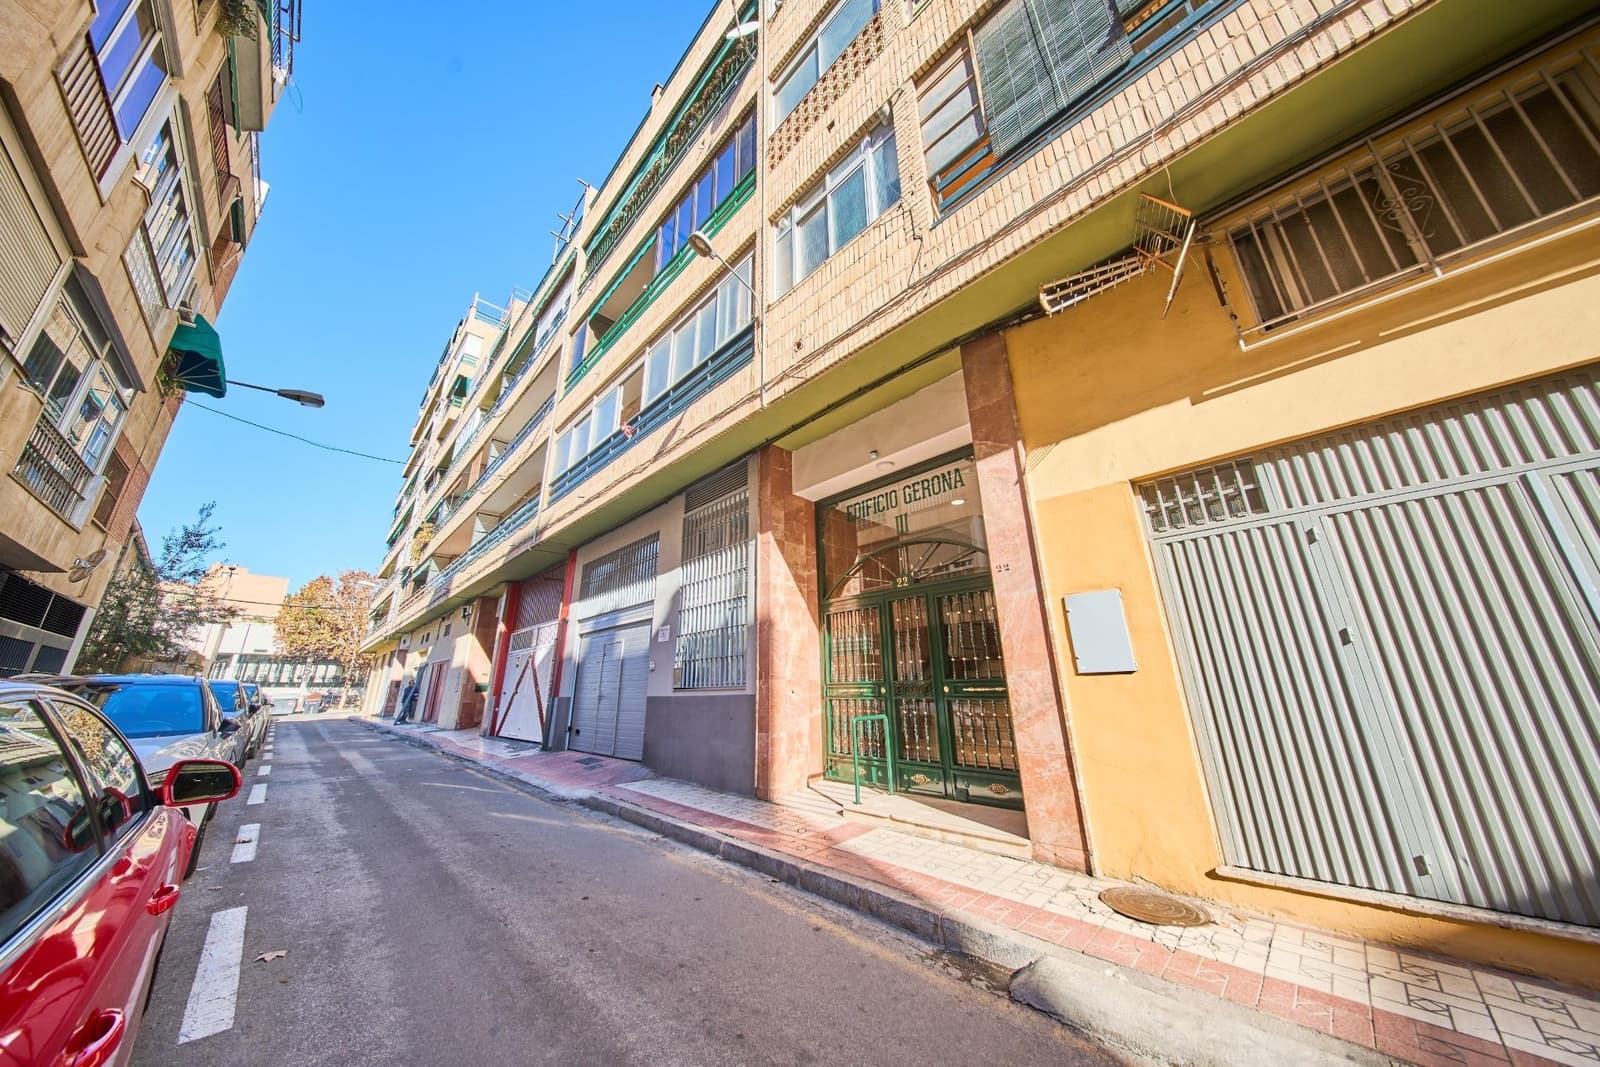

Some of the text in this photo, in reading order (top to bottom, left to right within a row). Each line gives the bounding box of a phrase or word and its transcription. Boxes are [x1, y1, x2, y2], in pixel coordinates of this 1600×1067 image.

[846, 468, 965, 521] EDIFICIO GERONA
[895, 512, 909, 535] III
[896, 576, 909, 588] 22
